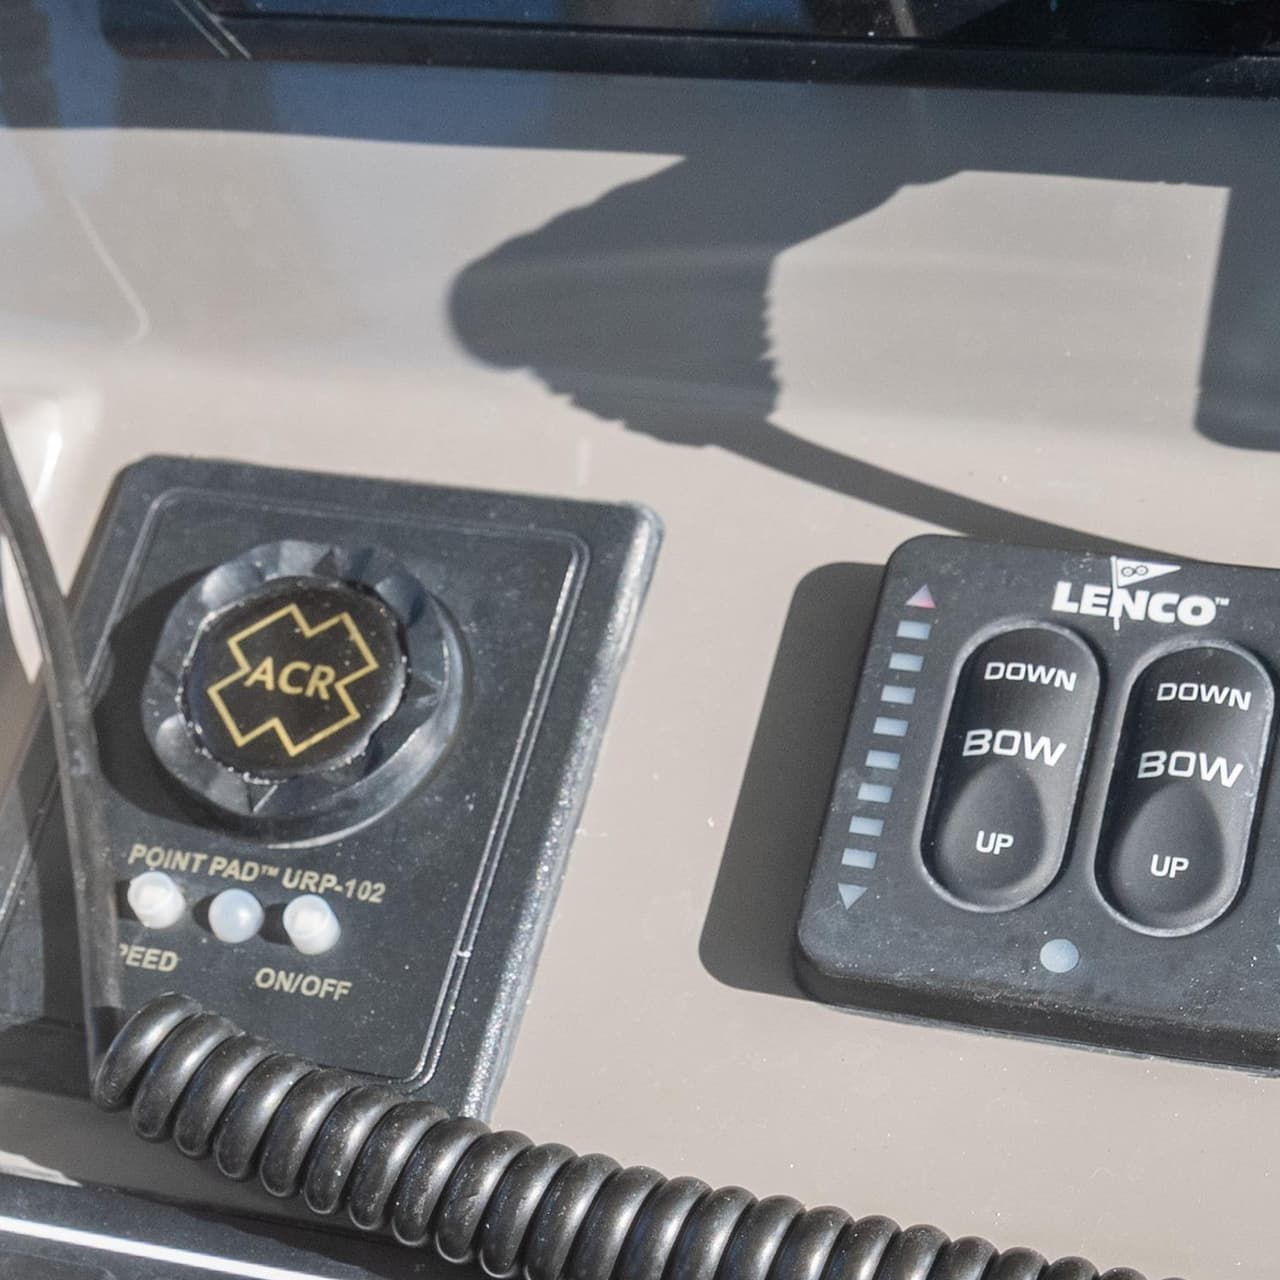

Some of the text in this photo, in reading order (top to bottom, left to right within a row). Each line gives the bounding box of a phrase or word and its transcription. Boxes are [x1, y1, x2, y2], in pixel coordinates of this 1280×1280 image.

[243, 656, 336, 701] ACR
[984, 661, 1077, 692] DOWN
[1156, 682, 1252, 711] DOWN
[962, 728, 1067, 768] BOW
[1137, 750, 1245, 789] BOW
[975, 830, 1014, 856] UP
[128, 843, 208, 874] POINT
[282, 868, 387, 904] URP-102
[1150, 853, 1190, 880] UP
[255, 966, 352, 1002] ON/OFF
